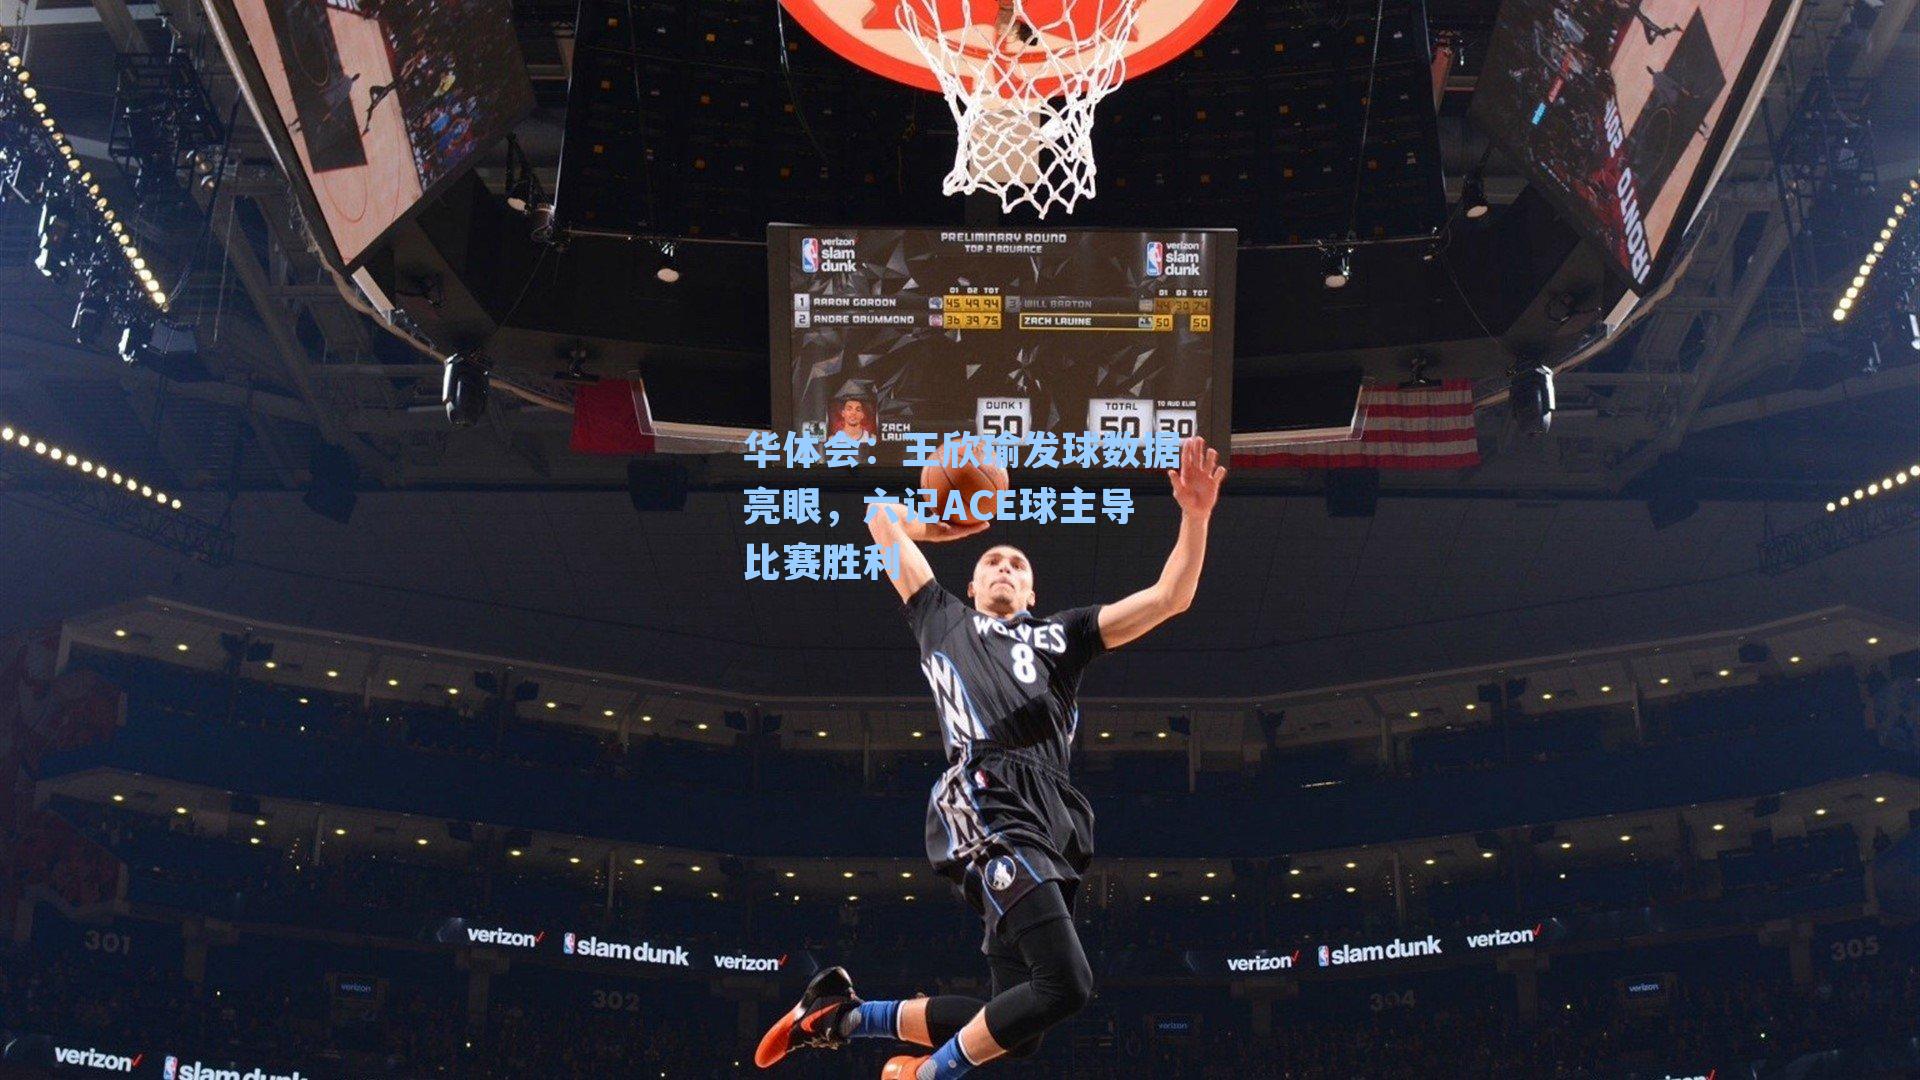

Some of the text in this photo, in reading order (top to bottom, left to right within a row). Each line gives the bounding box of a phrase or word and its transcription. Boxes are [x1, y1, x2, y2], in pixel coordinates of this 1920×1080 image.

[1617, 167, 1650, 284] RONTO
[821, 238, 855, 246] verizon
[941, 232, 1067, 243] PRELIMINARY ROUND
[965, 244, 1042, 254] TOP 2 ADVANCE
[1166, 241, 1199, 250] verizon
[821, 248, 856, 260] slam
[1165, 251, 1199, 263] slam
[821, 260, 857, 272] dunk
[1165, 264, 1199, 276] dunk
[813, 298, 850, 306] AARON
[852, 298, 897, 307] GORDON
[946, 299, 960, 308] 45
[965, 299, 980, 308] 49
[983, 299, 999, 308] 94
[1024, 300, 1046, 308] WILL
[1050, 299, 1092, 308] BARTON
[813, 315, 850, 323] ANDRE
[852, 315, 915, 324] DRUMMOND
[966, 316, 980, 325] 39
[984, 316, 999, 325] 75
[1024, 317, 1208, 327] ZACH LAVINE 50 50
[986, 401, 1016, 410] DUNK
[1105, 402, 1138, 411] TOTAL
[881, 423, 911, 432] ZACH
[983, 416, 1193, 438] 50 50 30
[1011, 643, 1037, 684] 8
[84, 930, 131, 955] 301
[467, 927, 536, 948] verizon
[1466, 927, 1534, 948] verizon
[577, 936, 690, 966] slam dunk
[1331, 935, 1442, 965] slam dunk
[1831, 934, 1880, 961] 305
[714, 953, 779, 971] verizon
[1227, 952, 1292, 971] verizon
[340, 982, 371, 993] verizon
[1629, 982, 1660, 992] verizon
[591, 990, 640, 1011] 302
[54, 1046, 132, 1072] verizon
[179, 1061, 240, 1080] slam
